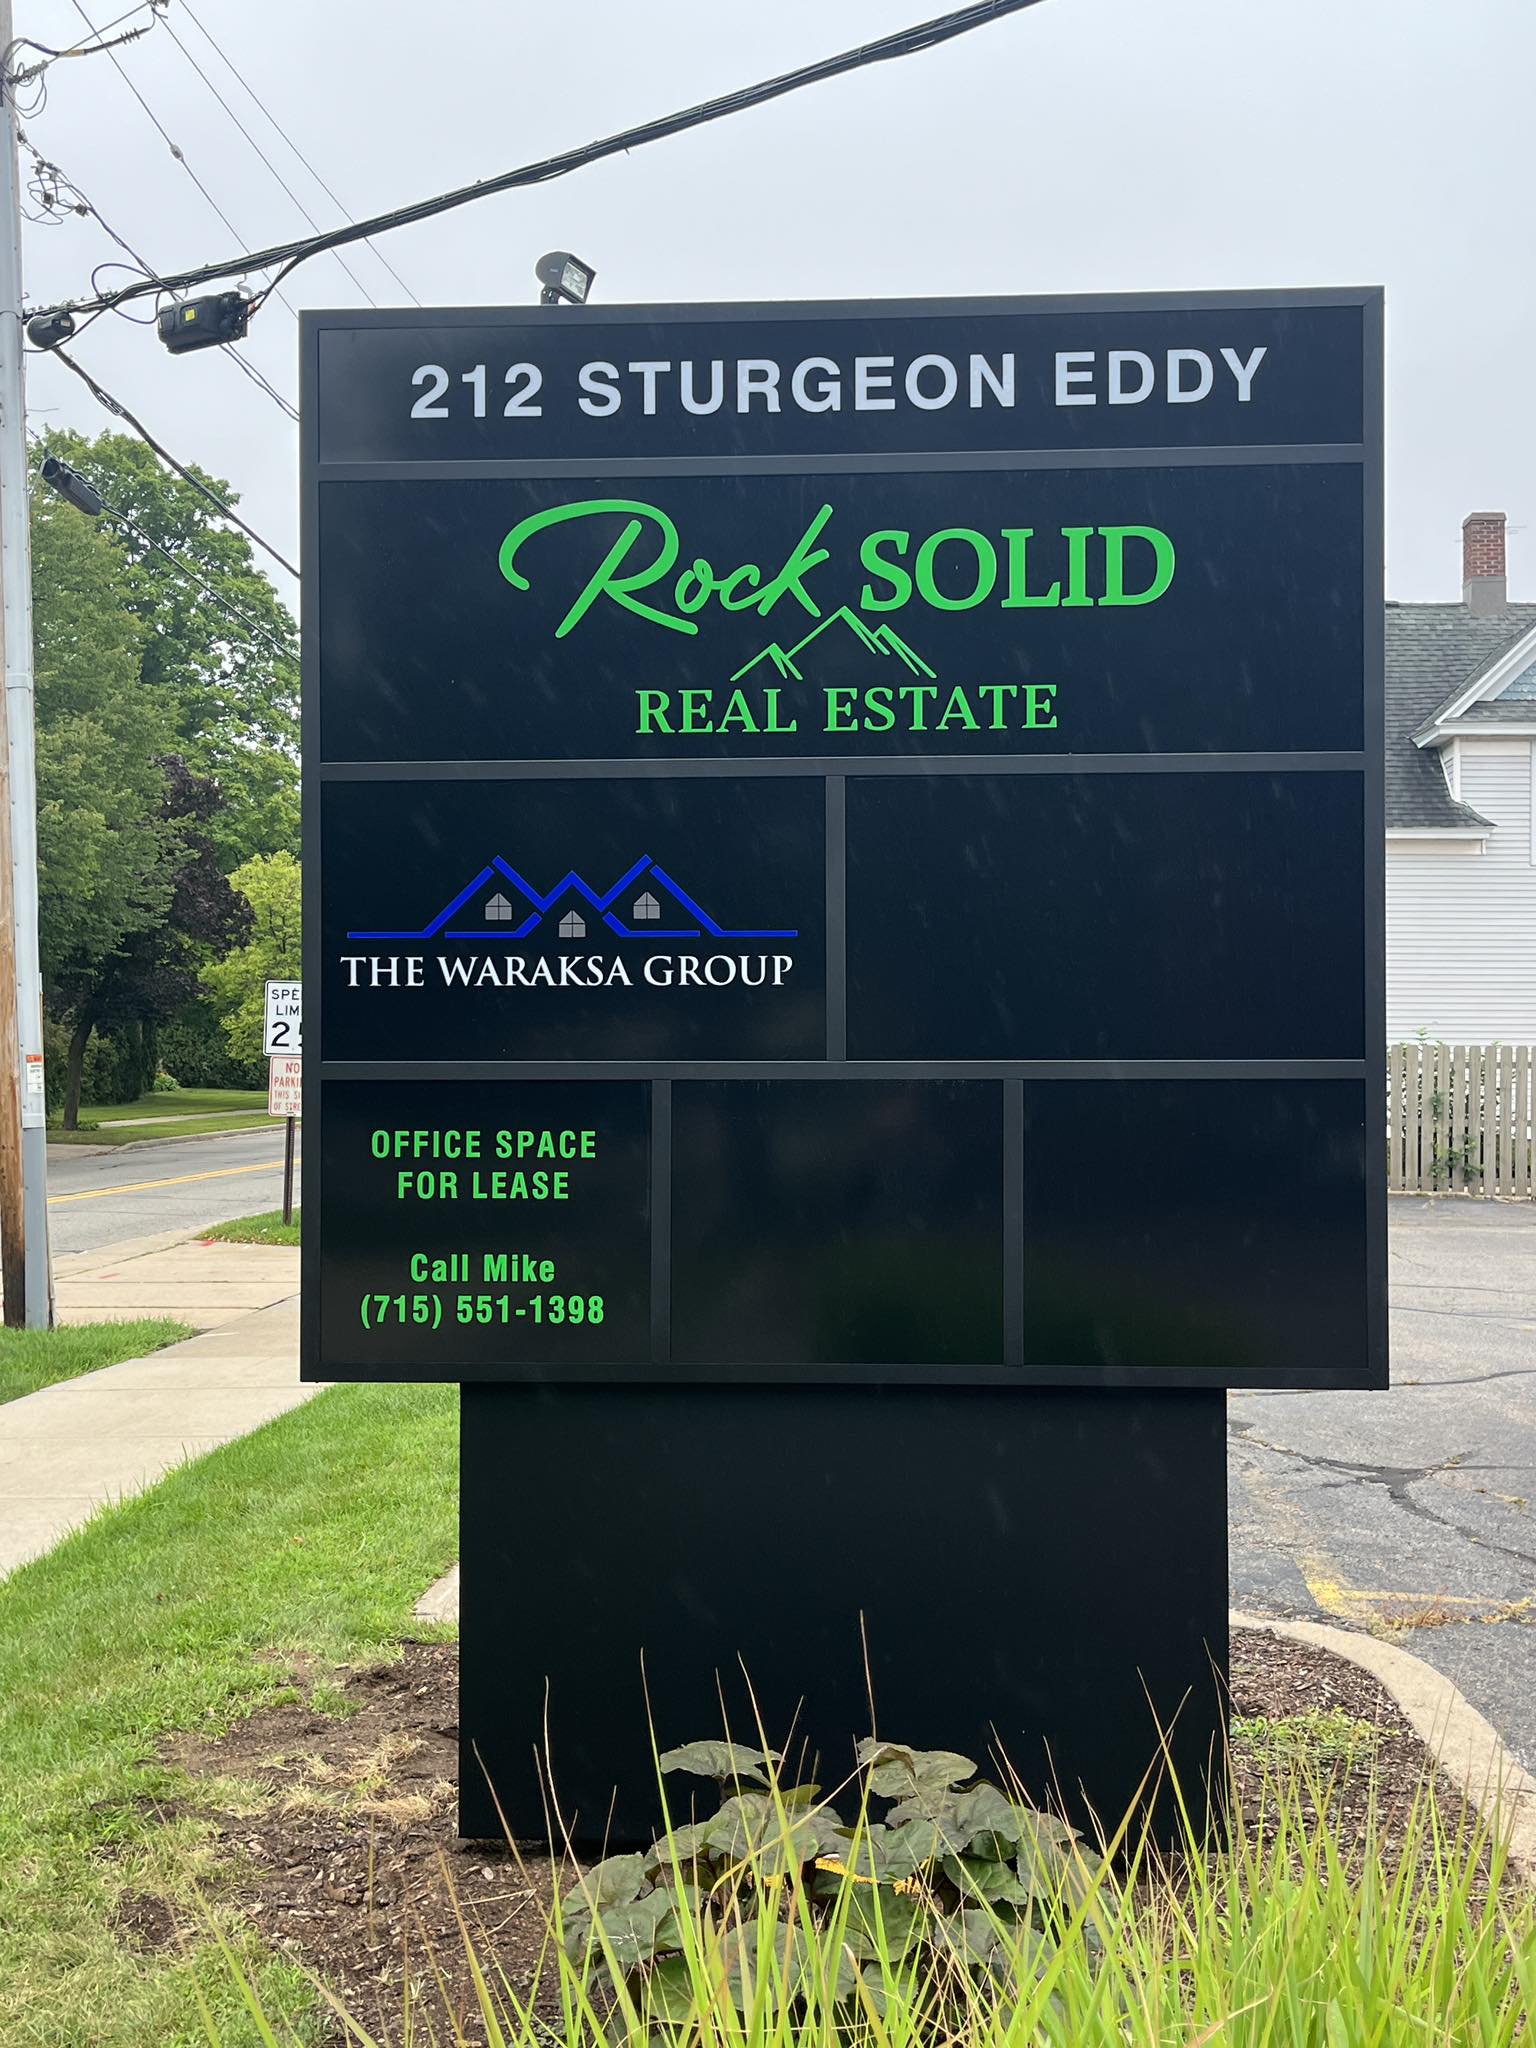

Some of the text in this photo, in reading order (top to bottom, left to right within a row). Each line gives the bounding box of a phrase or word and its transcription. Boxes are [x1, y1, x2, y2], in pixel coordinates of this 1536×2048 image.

[411, 347, 1268, 420] 212 STURGEON EDDY
[498, 498, 1176, 639] Rock SOLID
[634, 683, 1058, 735] REAL ESTATE
[339, 954, 793, 987] THE WARAKSA GROUP
[271, 989, 300, 1001] SPE
[276, 1005, 300, 1016] LIM
[271, 1021, 303, 1047] 2
[274, 1076, 303, 1088] PARKI
[285, 1062, 300, 1074] NO
[285, 1102, 301, 1111] STRE
[371, 1129, 597, 1159] OFFICE SPACE
[397, 1170, 570, 1200] FOR LEASE
[410, 1253, 556, 1283] Call Mike
[360, 1294, 605, 1330] (715) 551-1398
